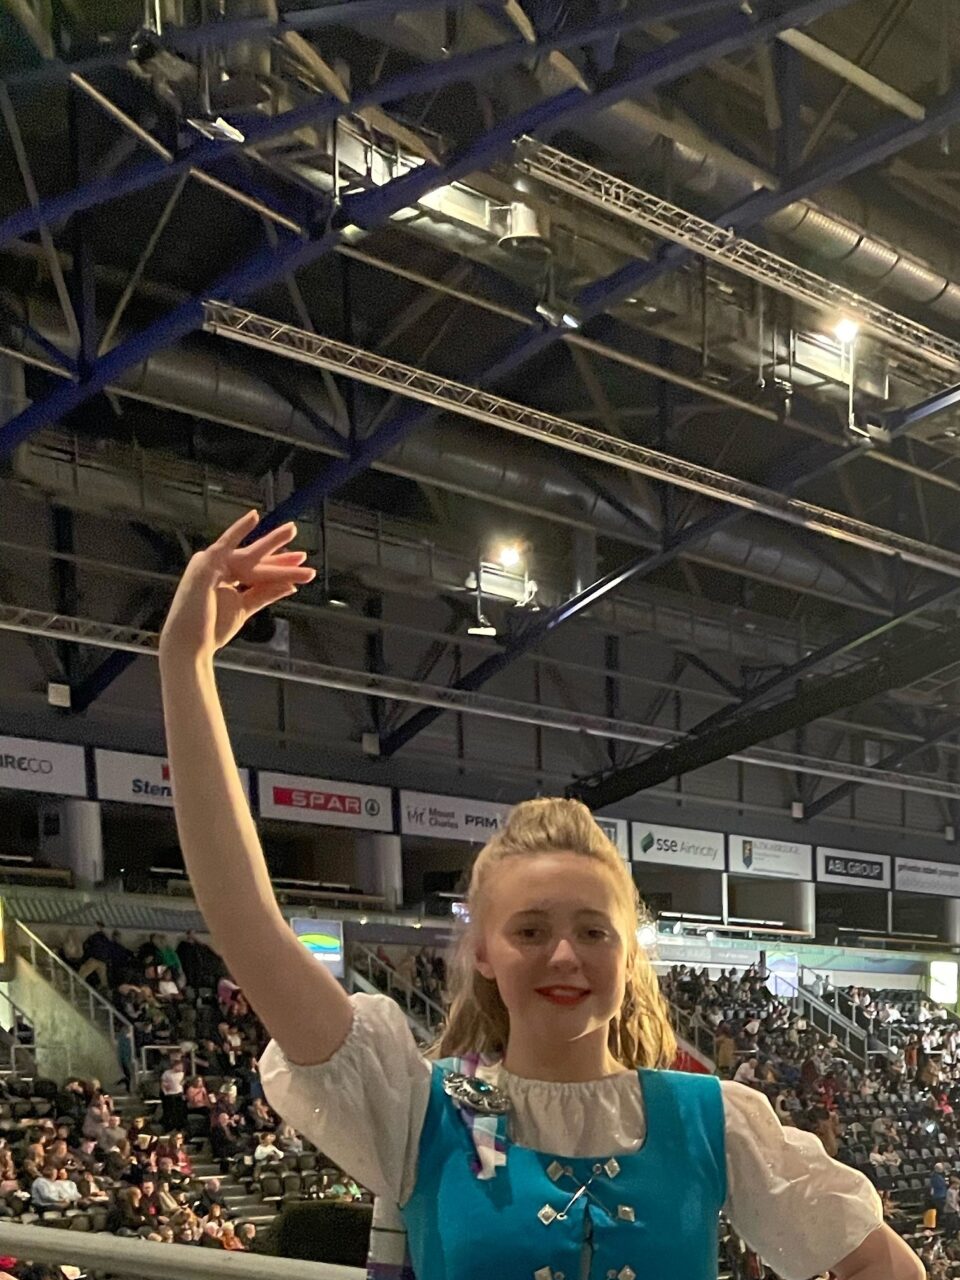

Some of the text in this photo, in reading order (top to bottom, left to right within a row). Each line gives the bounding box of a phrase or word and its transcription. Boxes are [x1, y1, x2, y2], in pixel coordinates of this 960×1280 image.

[132, 778, 172, 797] Sten
[291, 791, 360, 812] SPAR
[465, 814, 498, 829] PRM
[656, 838, 678, 853] sse
[828, 858, 847, 873] ABL
[847, 861, 880, 877] GROUP
